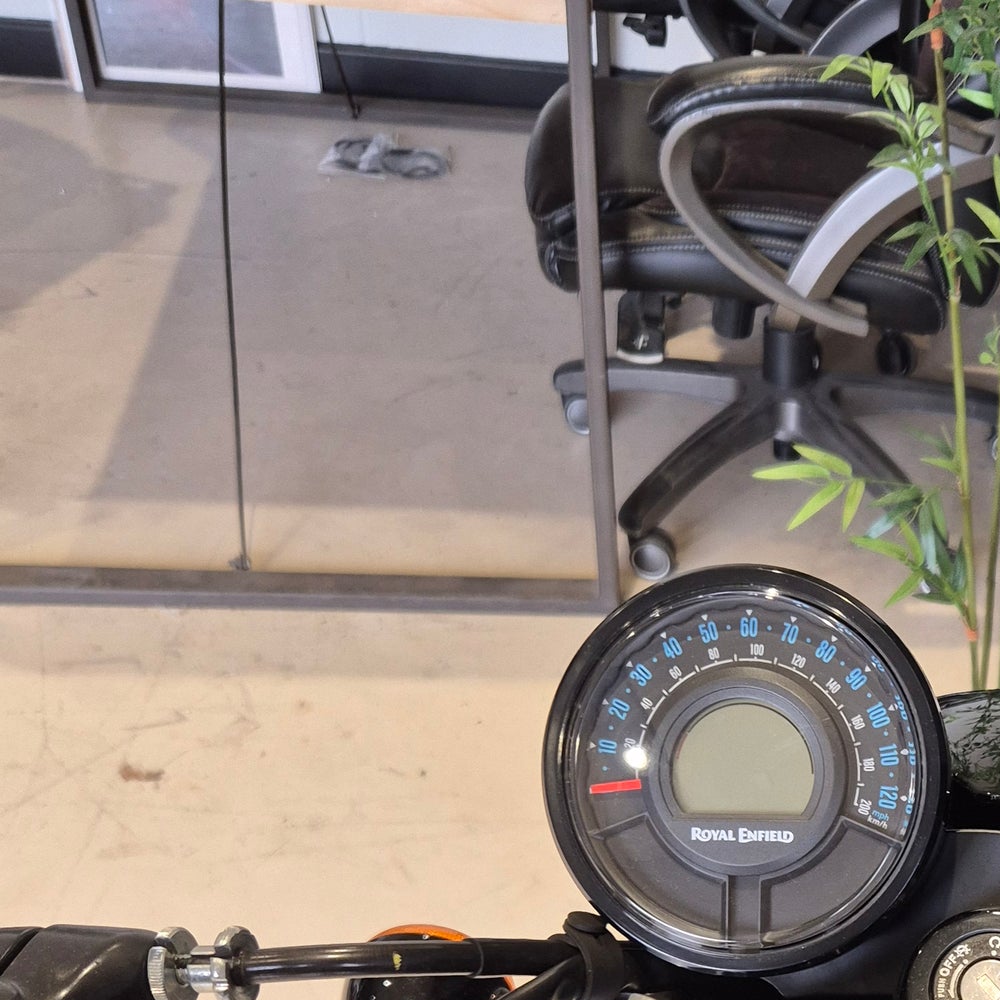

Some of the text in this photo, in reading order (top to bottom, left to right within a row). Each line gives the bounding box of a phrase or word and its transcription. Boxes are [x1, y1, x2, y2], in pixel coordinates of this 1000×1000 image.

[708, 647, 720, 660] 80
[750, 644, 764, 656] 100
[790, 654, 806, 668] 120
[668, 666, 682, 680] 60
[826, 678, 842, 694] 140
[640, 698, 653, 710] 40
[598, 616, 899, 822] 10 20 30 40 50 60 70 80 90 100 110 120 mph
[850, 714, 866, 730] 160
[862, 758, 875, 772] 180
[858, 798, 872, 816] 200
[867, 815, 888, 830] km/h
[691, 827, 794, 844] ROYAL ENFIELD
[940, 954, 958, 977] OFF
[938, 978, 946, 998] PUSH
